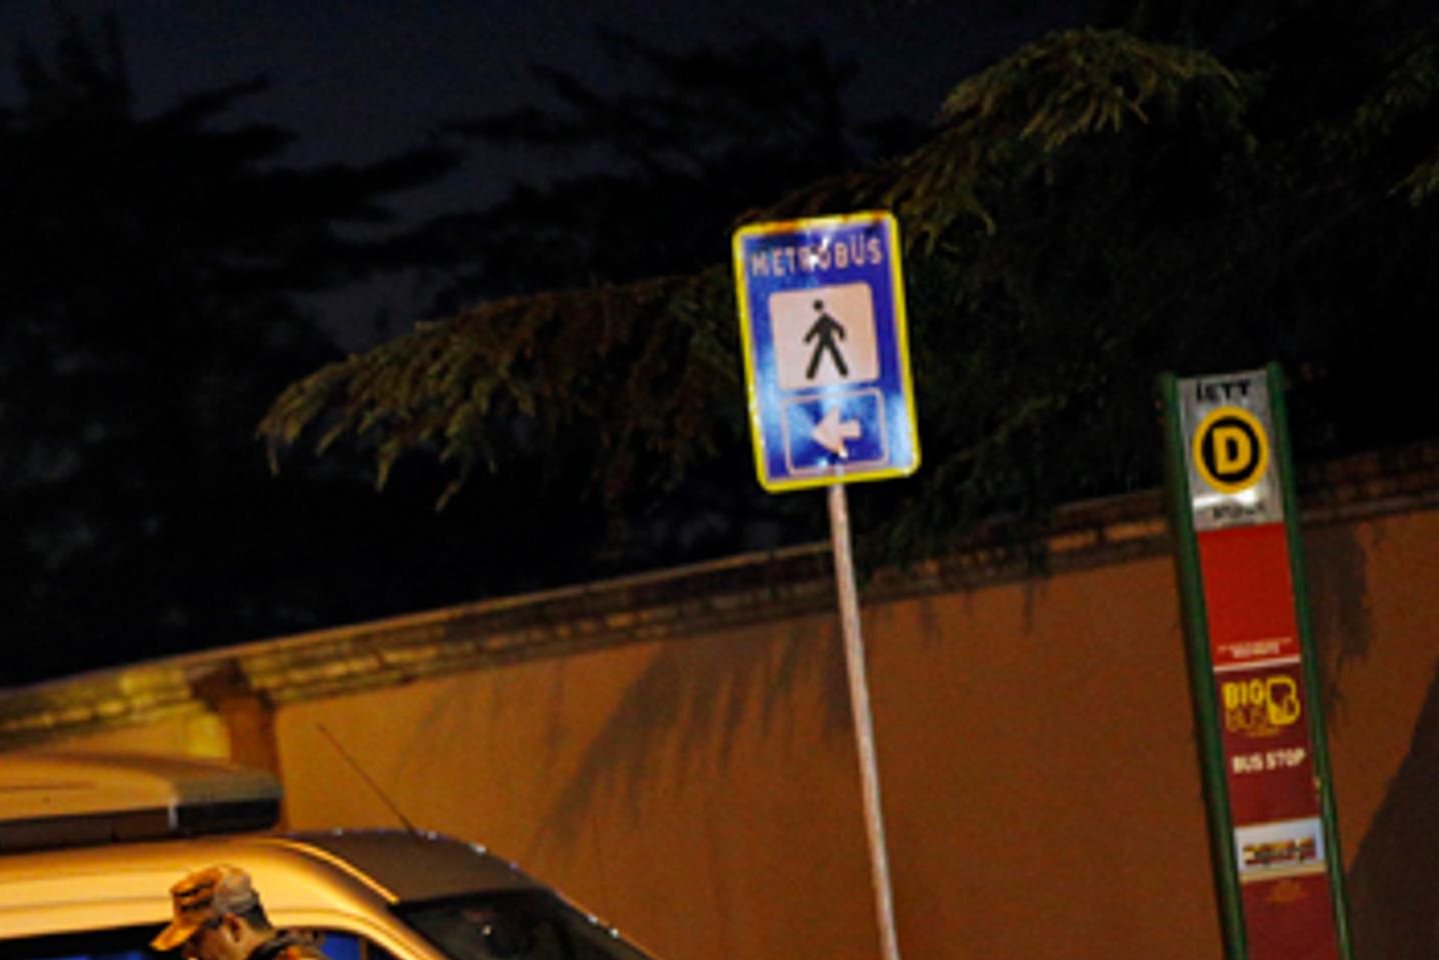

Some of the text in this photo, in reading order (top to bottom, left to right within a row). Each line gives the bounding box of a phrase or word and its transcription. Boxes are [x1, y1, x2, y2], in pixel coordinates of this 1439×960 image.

[1212, 425, 1252, 475] D
[1232, 748, 1306, 773] BUS STOP
